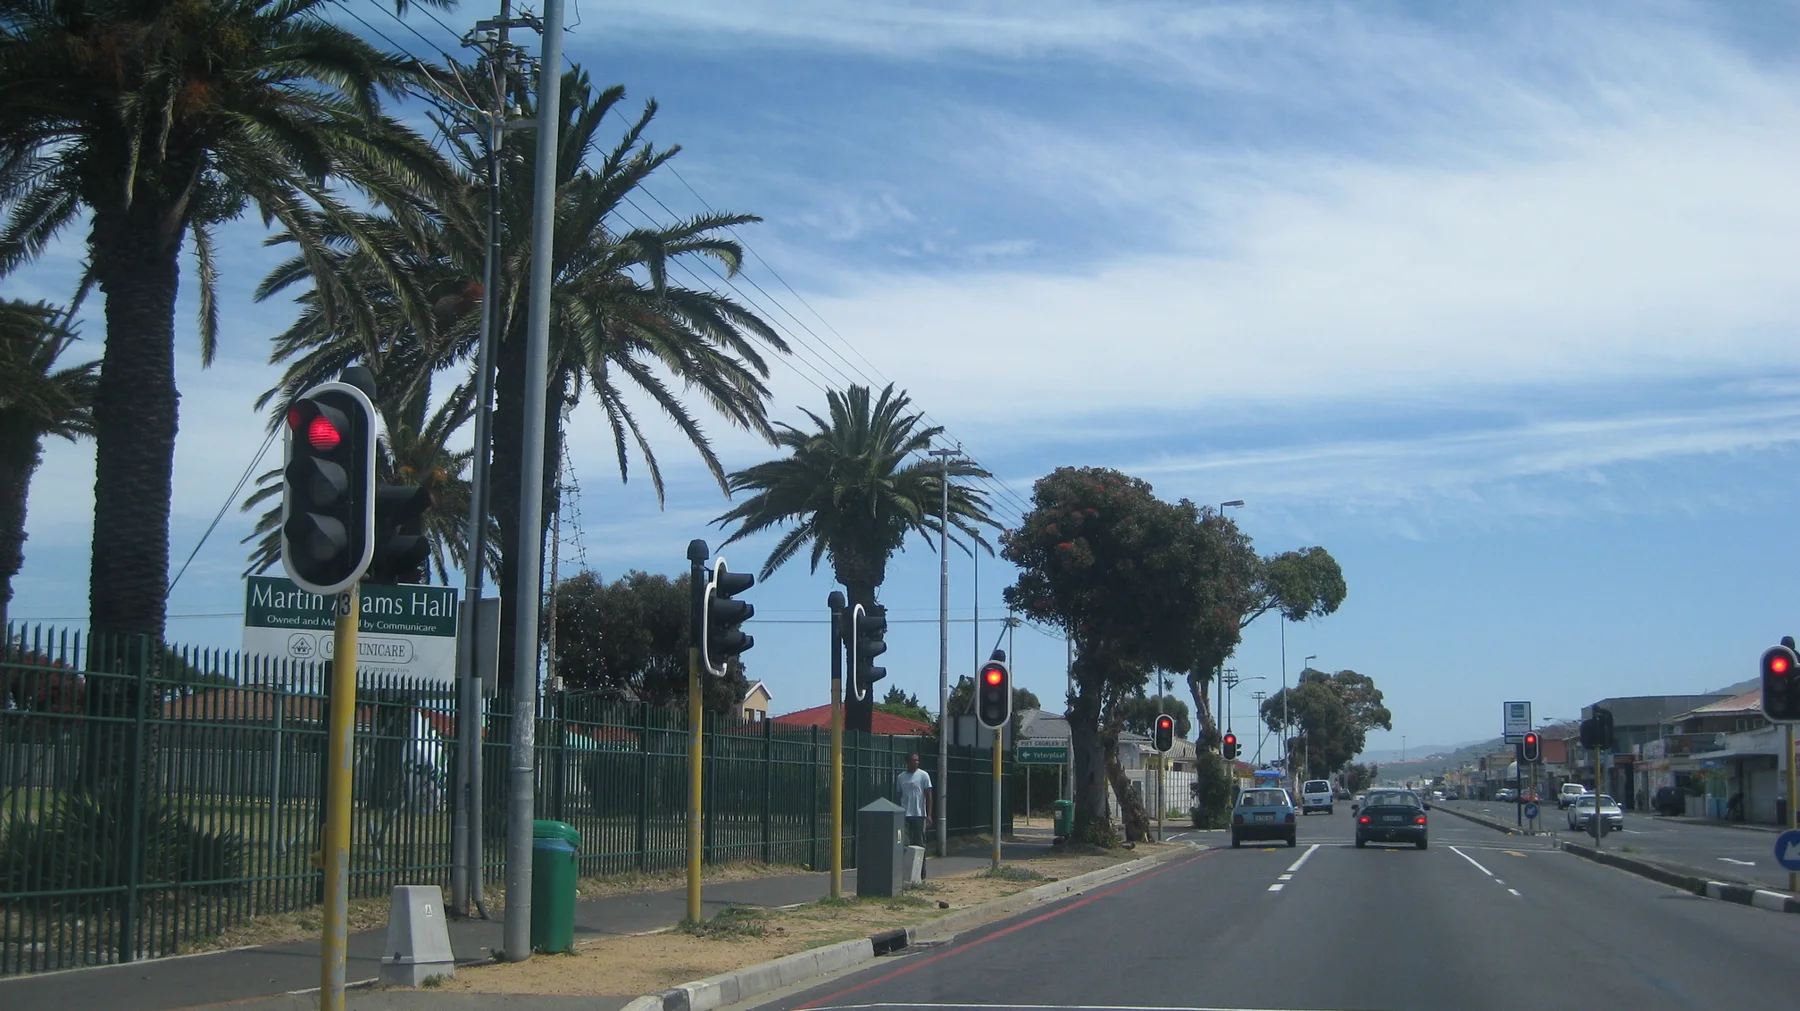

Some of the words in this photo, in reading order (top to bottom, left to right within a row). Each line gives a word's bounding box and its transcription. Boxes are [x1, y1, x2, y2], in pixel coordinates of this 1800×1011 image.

[252, 583, 324, 611] Martin
[331, 594, 403, 615] ams
[411, 592, 454, 618] Hall
[267, 615, 300, 625] Owned
[302, 616, 319, 626] and
[363, 620, 374, 631] by
[377, 620, 437, 633] Communicare
[326, 640, 406, 658] CUNICARE
